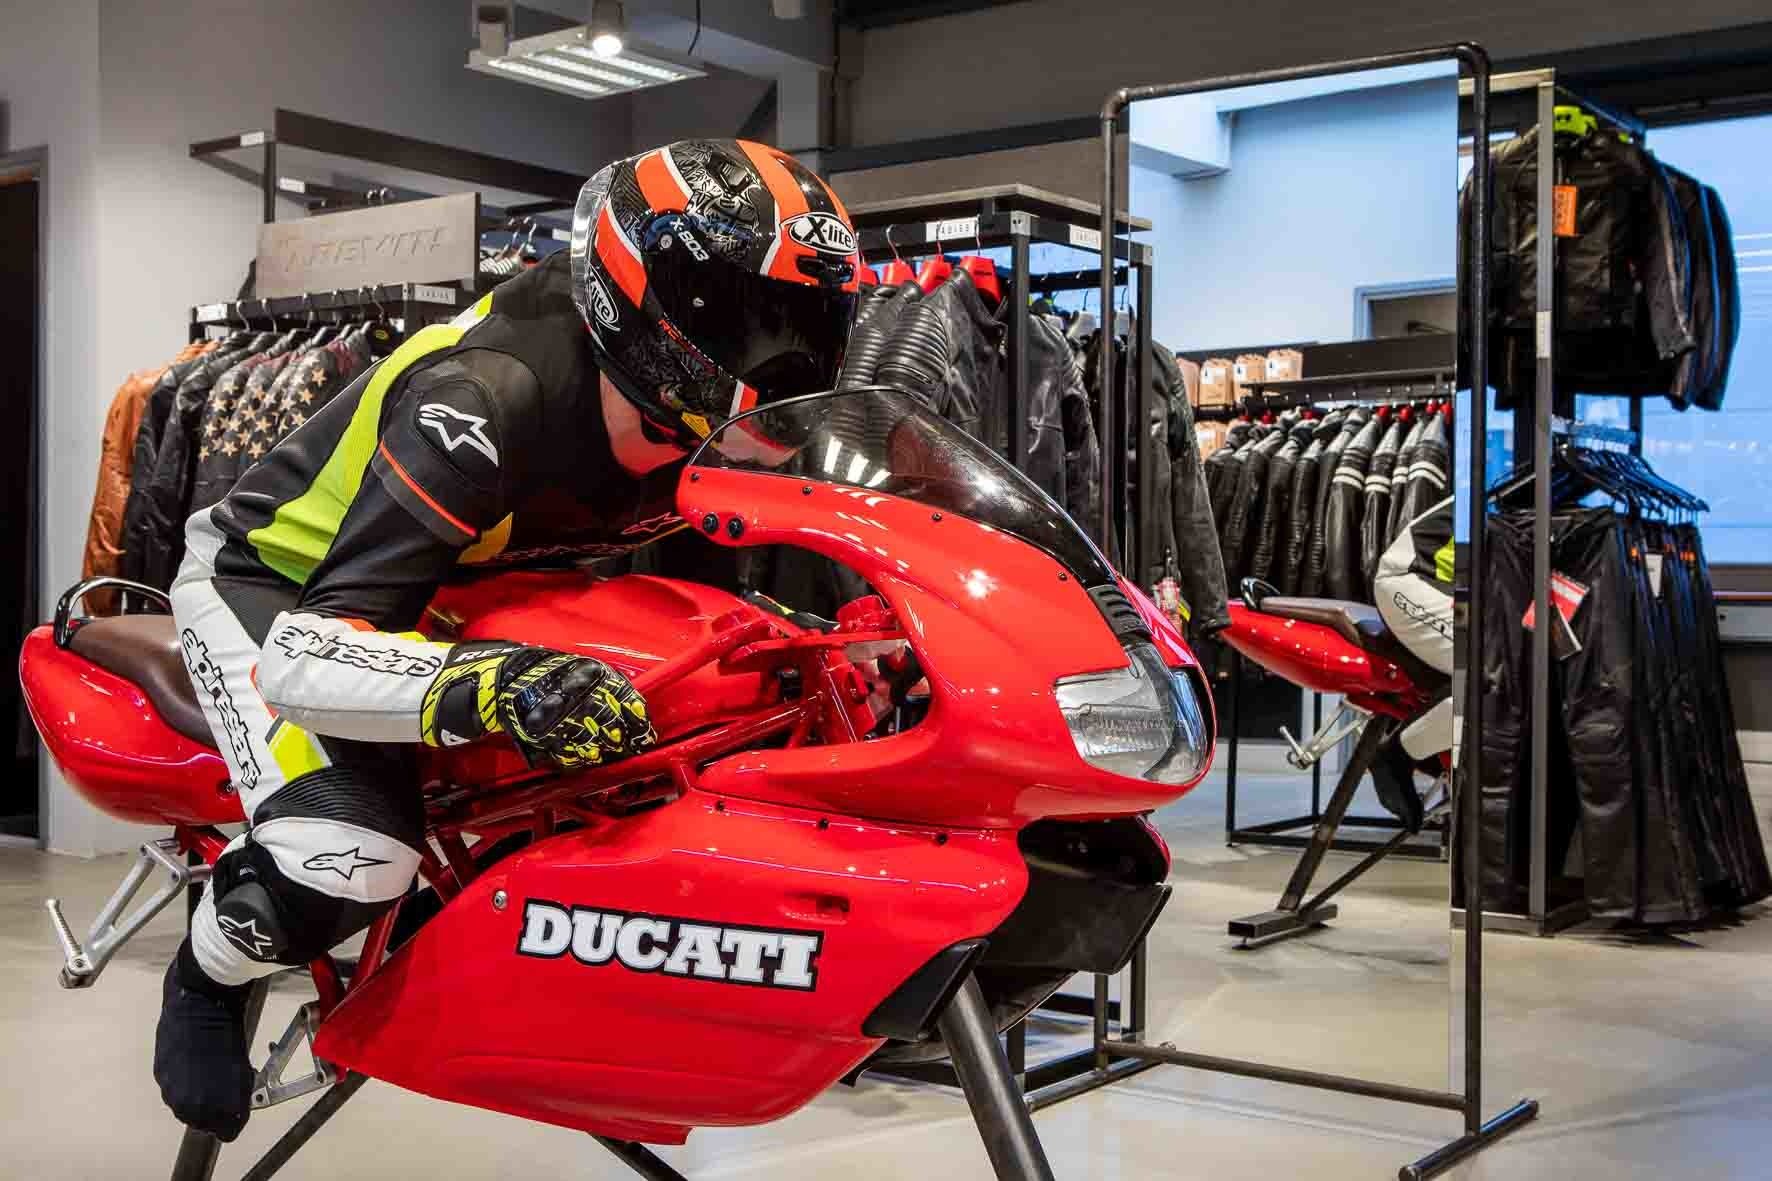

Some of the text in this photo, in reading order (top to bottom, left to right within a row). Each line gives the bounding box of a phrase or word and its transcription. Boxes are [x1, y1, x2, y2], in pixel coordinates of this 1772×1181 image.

[669, 216, 710, 261] X-803
[801, 216, 852, 250] X-lite
[274, 625, 442, 678] alpinestars
[181, 627, 262, 790] alpinestars
[518, 900, 820, 989] DUCATI
